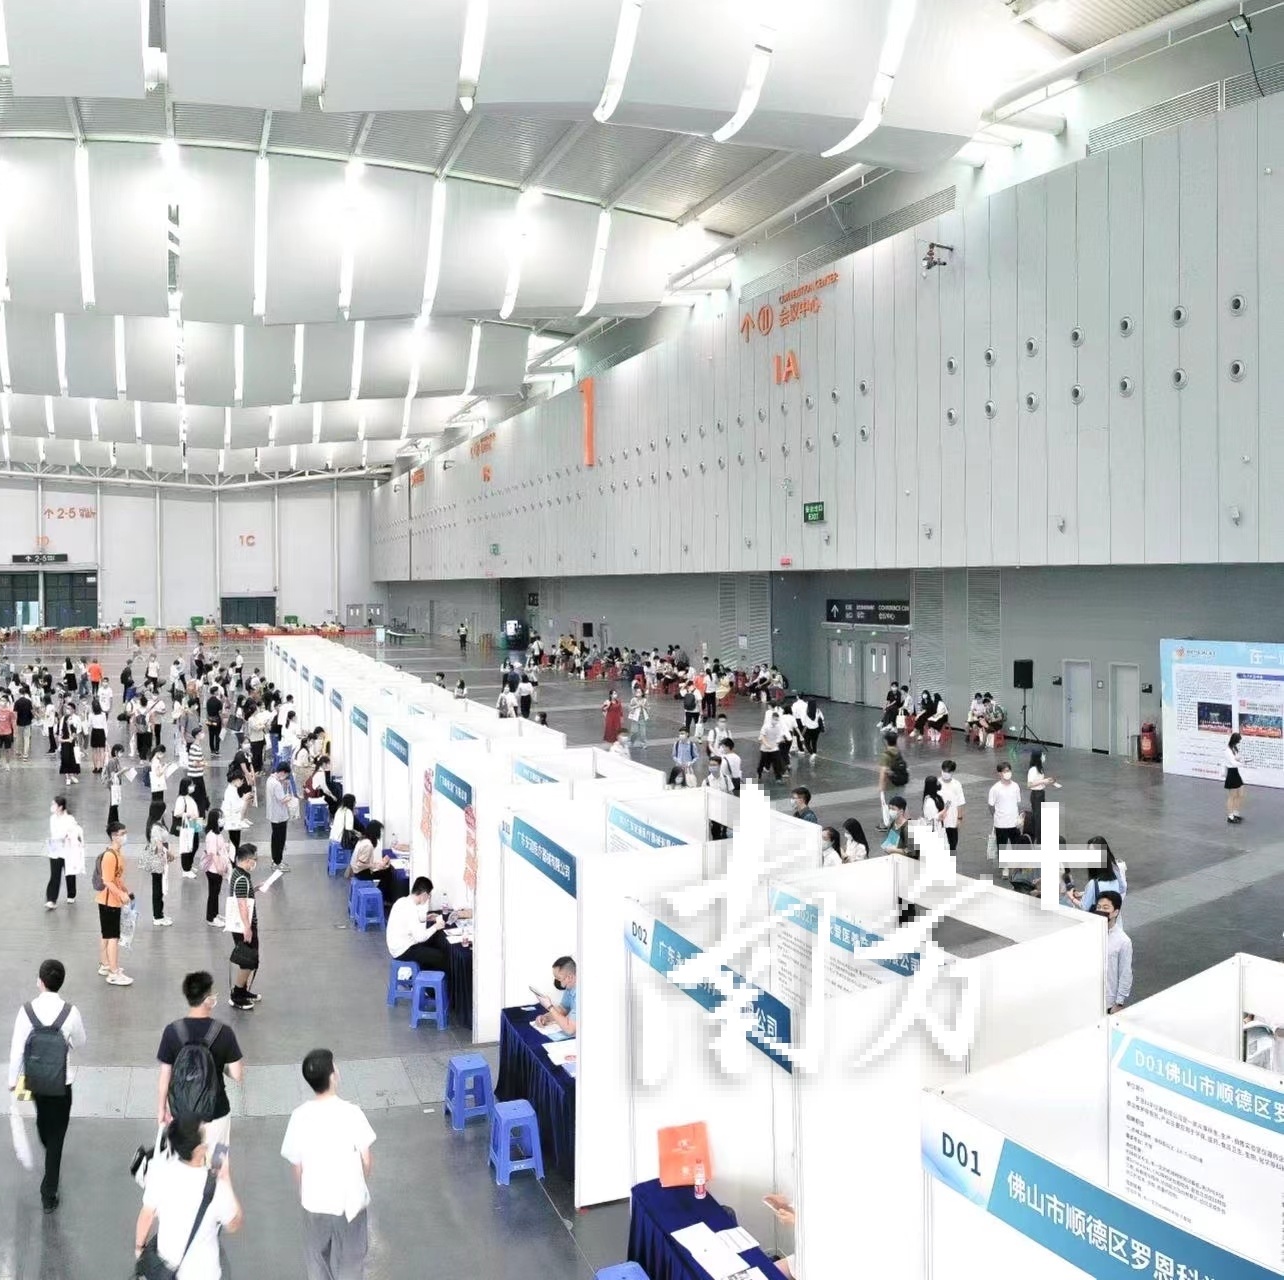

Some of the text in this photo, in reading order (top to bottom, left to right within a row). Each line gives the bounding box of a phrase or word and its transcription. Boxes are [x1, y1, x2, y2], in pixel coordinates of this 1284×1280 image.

[632, 921, 648, 945] D02
[942, 1131, 982, 1177] D01
[1007, 1170, 1216, 1280] 佛山市顺德区罗恩科
